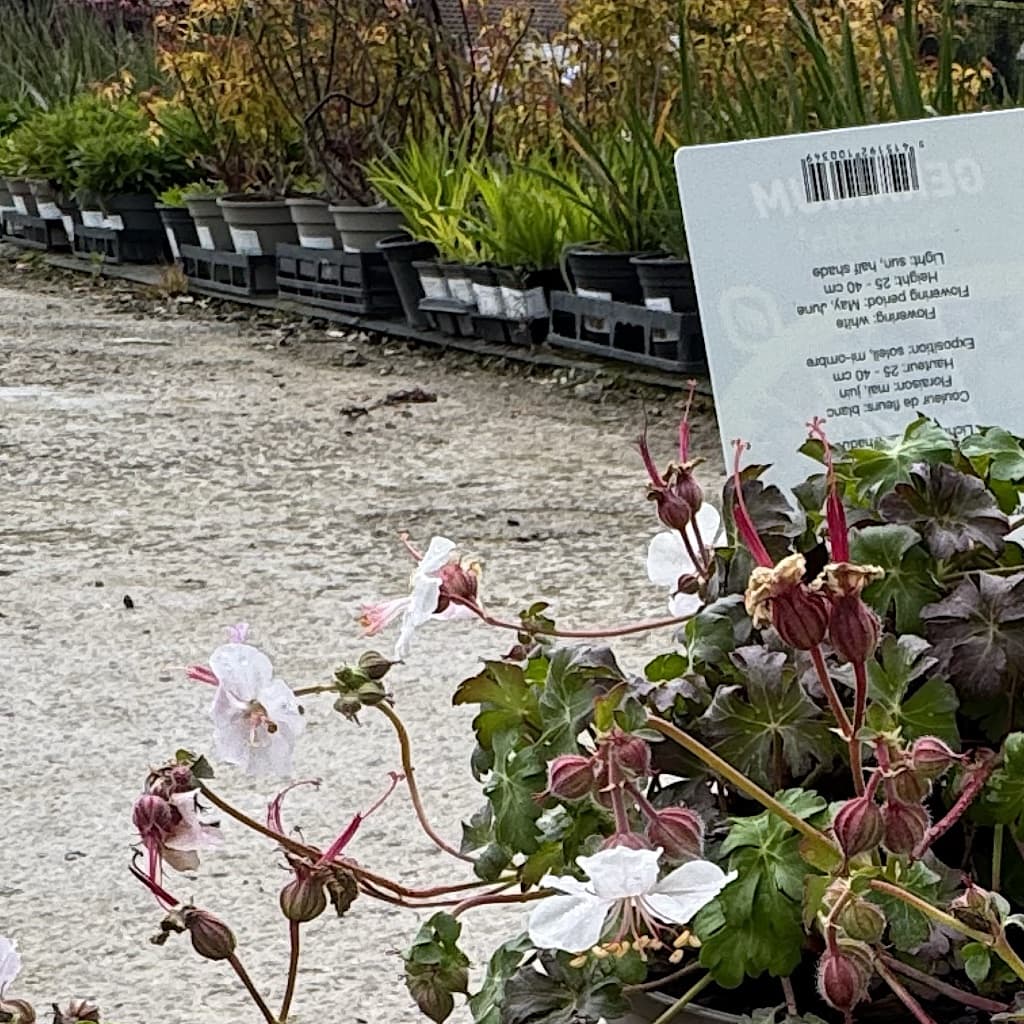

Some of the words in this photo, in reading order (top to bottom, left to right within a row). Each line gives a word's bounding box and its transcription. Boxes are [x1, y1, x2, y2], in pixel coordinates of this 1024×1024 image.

[879, 256, 907, 268] sun,
[910, 251, 945, 267] Light:
[812, 264, 851, 278] shade
[853, 261, 877, 276] half
[874, 277, 891, 290] 25
[894, 270, 938, 287] Height:
[823, 283, 843, 295] cm
[847, 281, 862, 294] 40
[910, 284, 969, 301] Flowering
[830, 298, 860, 312] May,
[863, 290, 907, 308] period:
[796, 301, 828, 316] June
[872, 306, 936, 323] Flowering:
[836, 315, 869, 330] white
[868, 345, 905, 361] soleil,
[909, 337, 975, 354] Exposition:
[806, 351, 866, 367] mi-ombre
[902, 357, 954, 374] Hauteur:
[832, 370, 852, 382] cm
[855, 368, 871, 382] 40
[883, 364, 899, 378] 25
[863, 382, 890, 397] mai,
[894, 374, 952, 391] Floraison:
[839, 383, 861, 399] juin
[922, 390, 970, 405] Couleur
[863, 398, 901, 413] fleurs:
[903, 395, 919, 409] de
[825, 404, 860, 418] blanc
